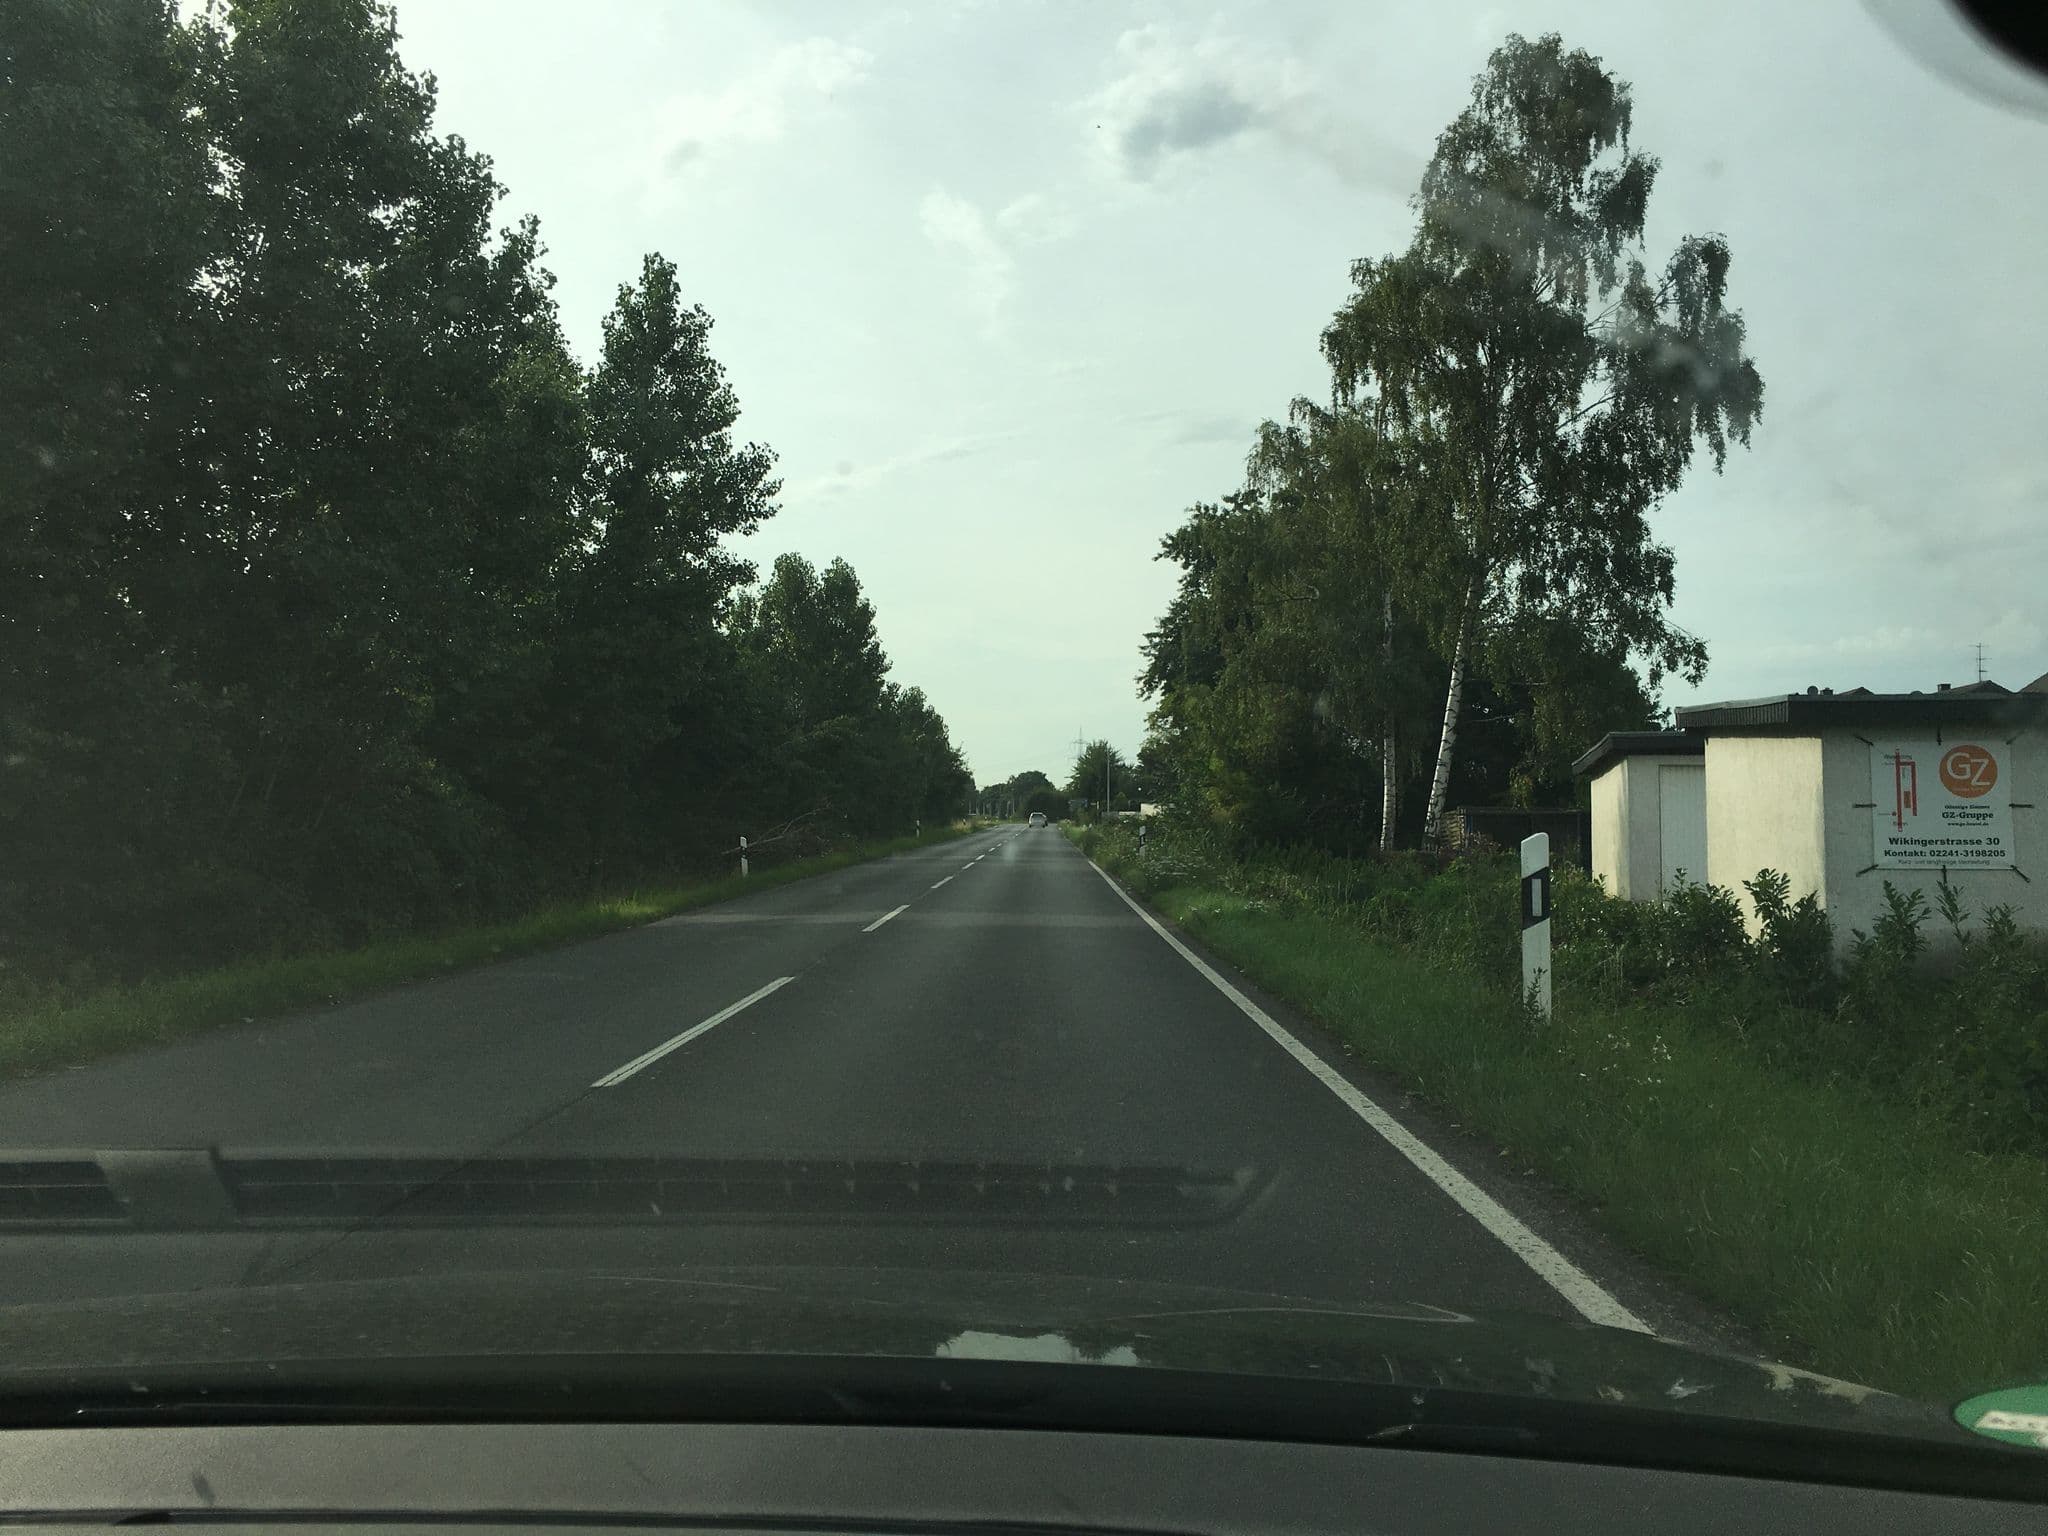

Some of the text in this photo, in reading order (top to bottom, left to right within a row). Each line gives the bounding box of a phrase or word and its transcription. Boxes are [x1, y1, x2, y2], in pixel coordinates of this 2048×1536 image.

[1946, 752, 1991, 786] GZ
[1942, 811, 1994, 820] GZ-Gruppe
[1889, 837, 2000, 847] Wikingerstrasse 30
[1884, 849, 2006, 857] Kontakt: 02241-3198205
